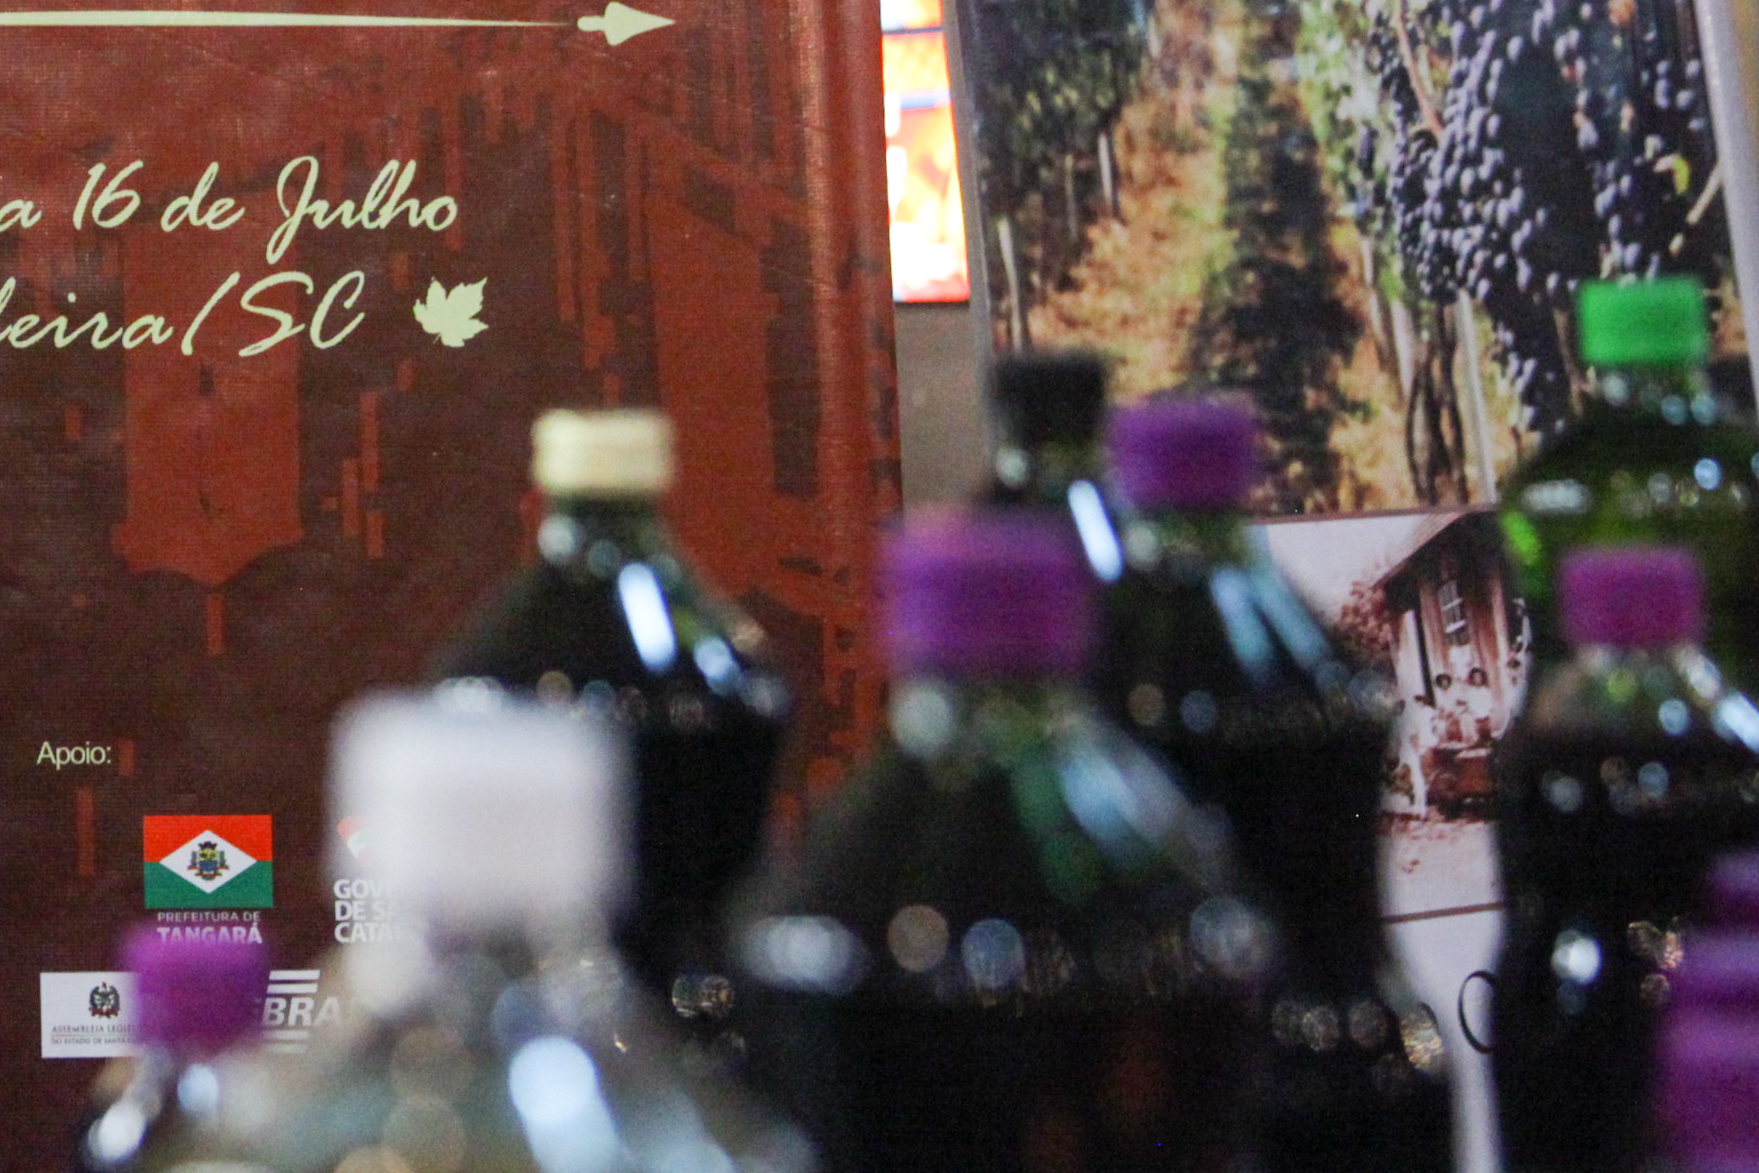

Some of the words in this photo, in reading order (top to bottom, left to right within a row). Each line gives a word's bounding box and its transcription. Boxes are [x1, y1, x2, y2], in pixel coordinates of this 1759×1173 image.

[72, 160, 145, 230] 16
[160, 162, 245, 231] de
[266, 155, 458, 264] Julho
[37, 741, 111, 770] Apoio:
[157, 911, 239, 922] PREFEITURA
[243, 911, 261, 922] DE
[334, 900, 366, 921] DE
[157, 922, 263, 944] TANGARÁ
